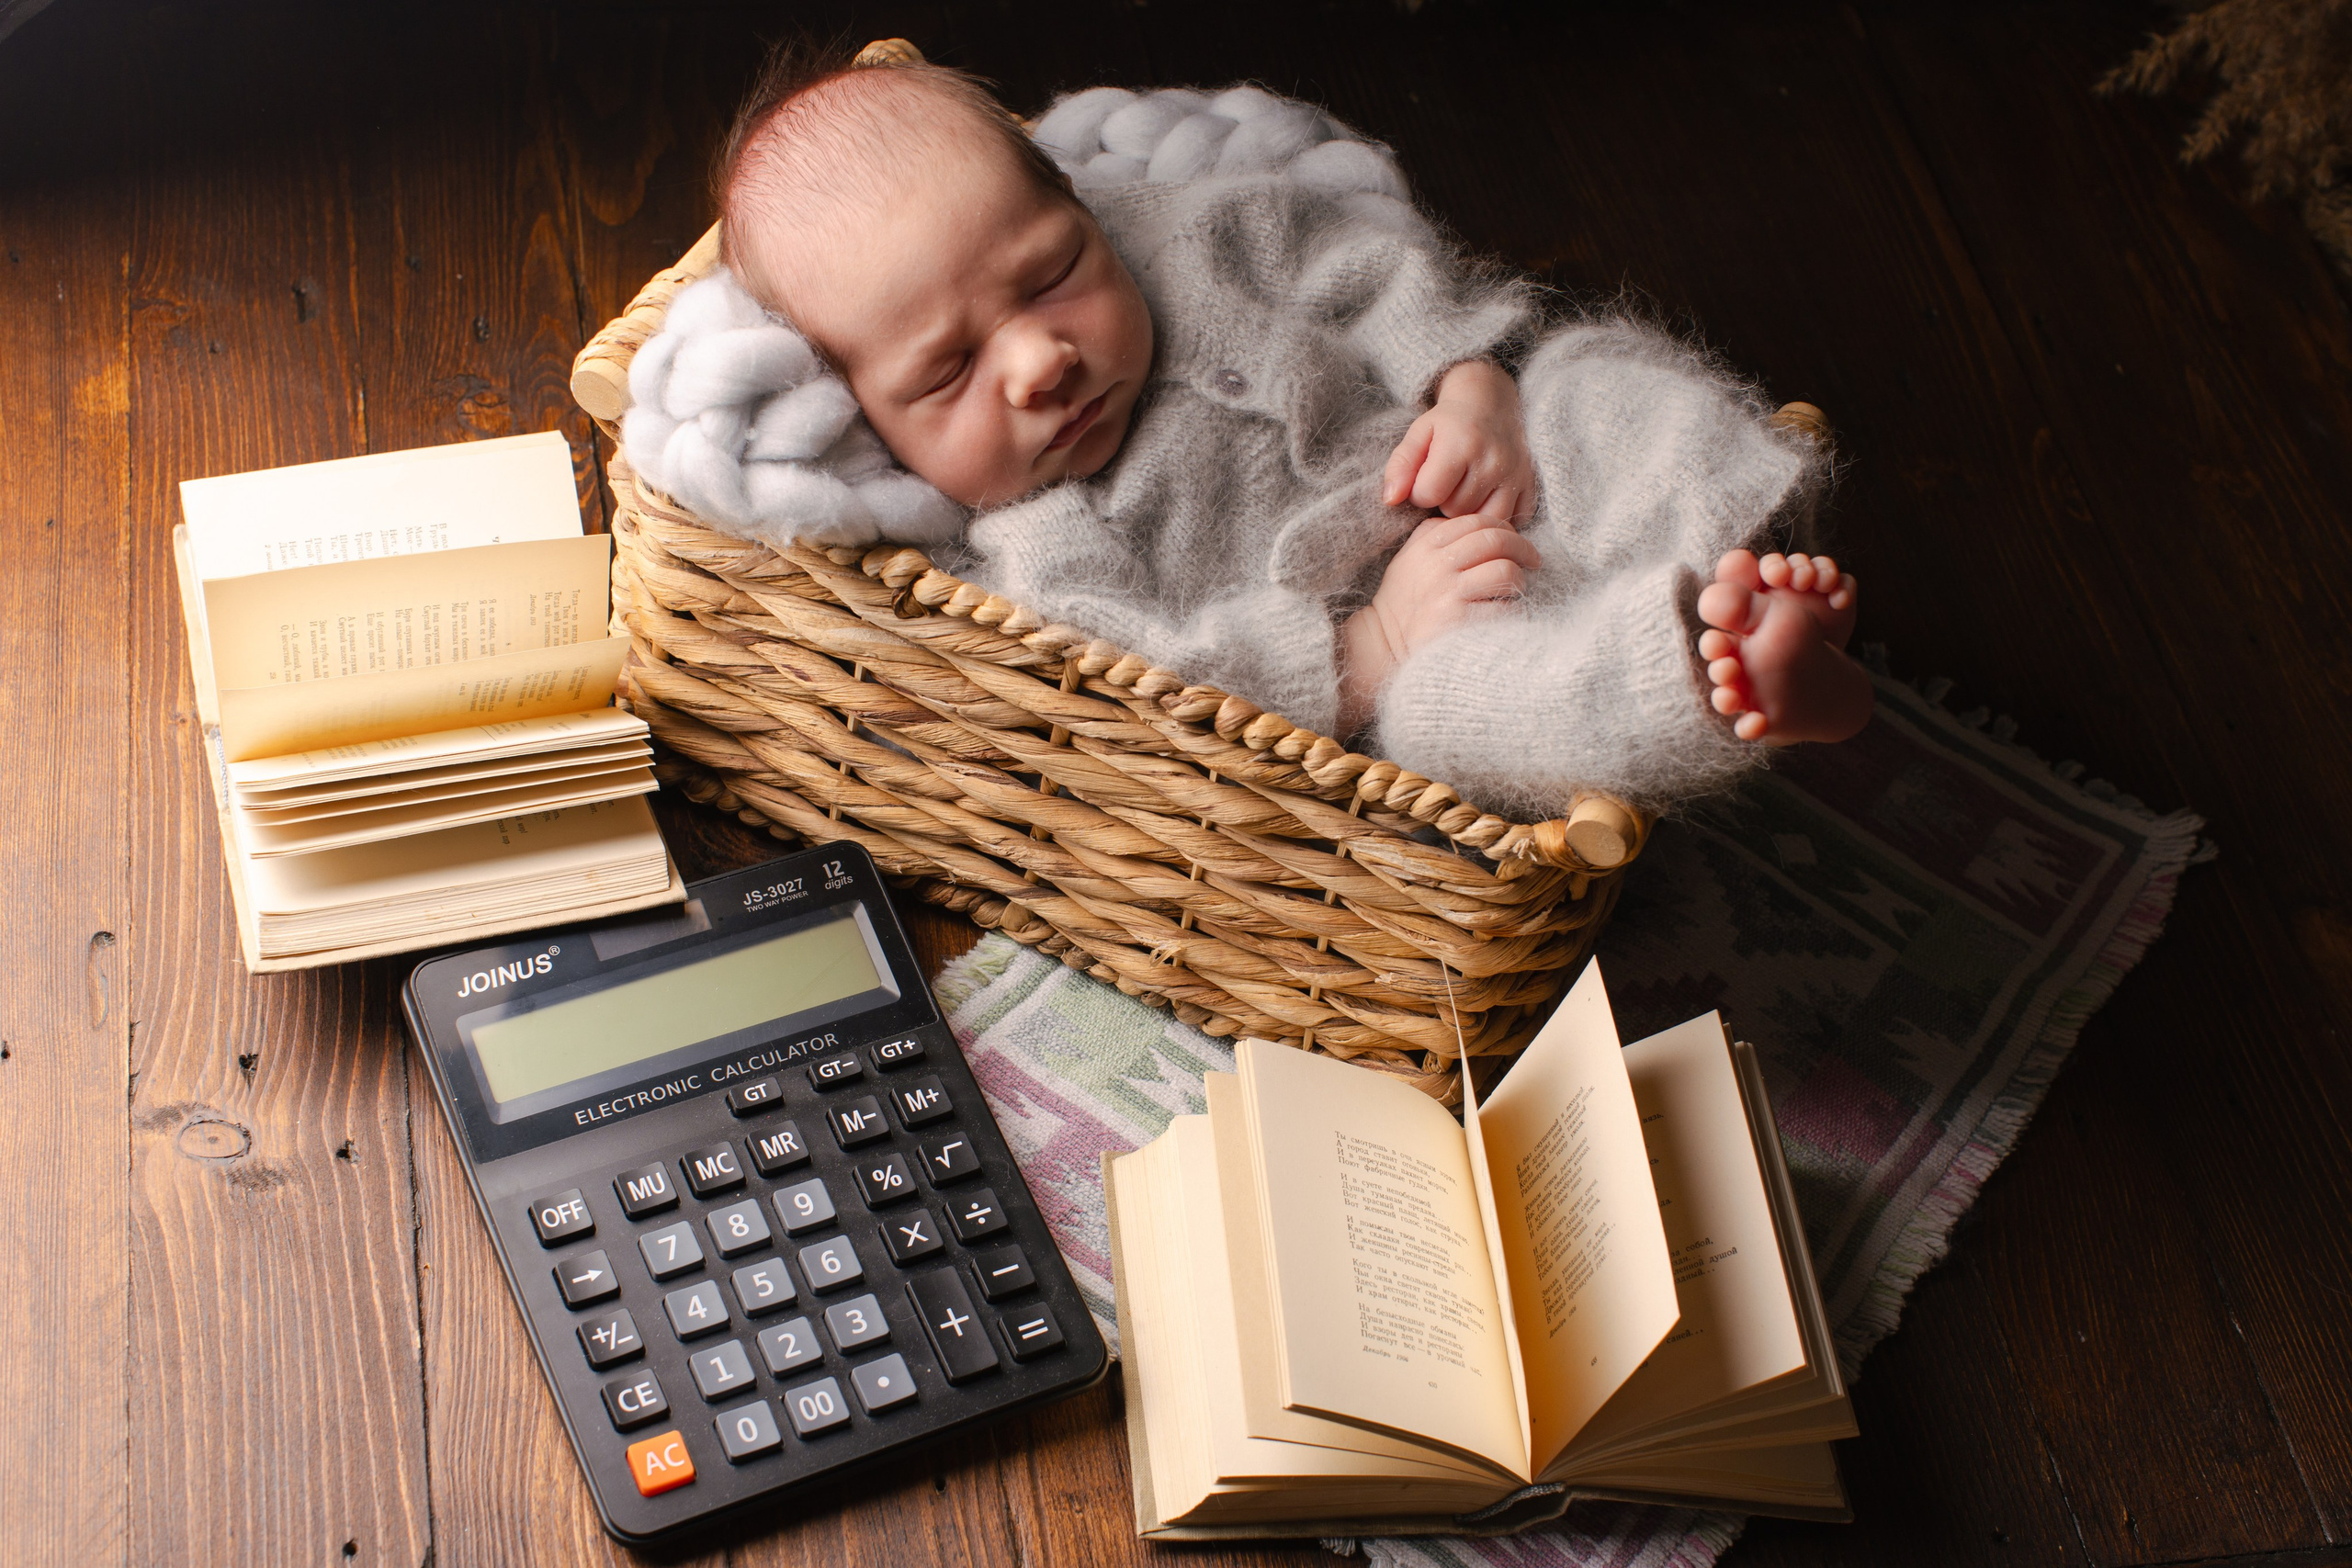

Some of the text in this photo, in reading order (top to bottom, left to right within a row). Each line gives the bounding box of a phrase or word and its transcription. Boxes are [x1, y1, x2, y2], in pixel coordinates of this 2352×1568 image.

[822, 861, 844, 878] 12
[825, 875, 854, 889] digits
[743, 877, 803, 905] JS-3027
[746, 890, 808, 913] TWO WAY POWER
[881, 1040, 915, 1057] GT+
[574, 1032, 840, 1125] ELECTRONIC CALCULATOR
[744, 1083, 766, 1100] GT
[905, 1089, 939, 1111] M+
[760, 1133, 798, 1158] MR
[1335, 1131, 1346, 1140] Ты
[1351, 1137, 1387, 1152] смотришь
[1400, 1153, 1412, 1161] очи
[1348, 1145, 1369, 1155] город
[1374, 1152, 1397, 1163] ставит
[695, 1152, 734, 1180] MC
[873, 1165, 902, 1190] %
[1339, 1156, 1360, 1168] Поют
[1364, 1164, 1405, 1181] фабричные
[1358, 1156, 1396, 1170] переулках
[1401, 1169, 1423, 1181] пахнет
[628, 1172, 665, 1201] MU
[1341, 1181, 1364, 1193] Душа
[1371, 1190, 1403, 1204] туманам
[1362, 1180, 1431, 1208] суете непобедимой
[795, 1193, 813, 1215] 9
[1342, 1190, 1357, 1199] Вот
[1363, 1197, 1395, 1210] красный
[542, 1199, 583, 1227] OFF
[729, 1214, 749, 1236] 8
[1344, 1198, 1437, 1234] Вот женский голос, как
[1360, 1220, 1394, 1235] помыслы
[1399, 1232, 1415, 1241] твои
[658, 1235, 676, 1260] 7
[1347, 1224, 1450, 1263] Как складки современных
[1350, 1241, 1429, 1271] Так часто опускают
[1362, 1238, 1397, 1251] женщины
[1686, 1237, 1713, 1252] собой,
[1709, 1247, 1737, 1263] душой
[821, 1250, 841, 1273] 6
[753, 1272, 774, 1296] 5
[1352, 1258, 1372, 1269] Кого
[1402, 1273, 1438, 1290] скользкой
[1442, 1288, 1457, 1299] мгле
[1354, 1268, 1448, 1303] Чьи окна светят сквозь
[1354, 1276, 1435, 1306] Здесь ресторан, как
[688, 1295, 707, 1318] 4
[1369, 1290, 1437, 1315] храм открыт, как
[846, 1310, 867, 1333] 3
[1359, 1303, 1457, 1339] На безысходные обманы
[1360, 1312, 1383, 1325] Душа
[1389, 1321, 1424, 1336] напрасно
[778, 1334, 801, 1359] 2
[1361, 1329, 1465, 1368] Погаснут все урочный
[1363, 1345, 1391, 1358] Декабрь
[1373, 1325, 1396, 1337] взоры
[1427, 1341, 1463, 1358] рестораны
[710, 1357, 733, 1382] 1
[618, 1382, 657, 1411] CE
[799, 1392, 833, 1420] 00
[738, 1417, 757, 1441] 0
[647, 1443, 684, 1475] AC
